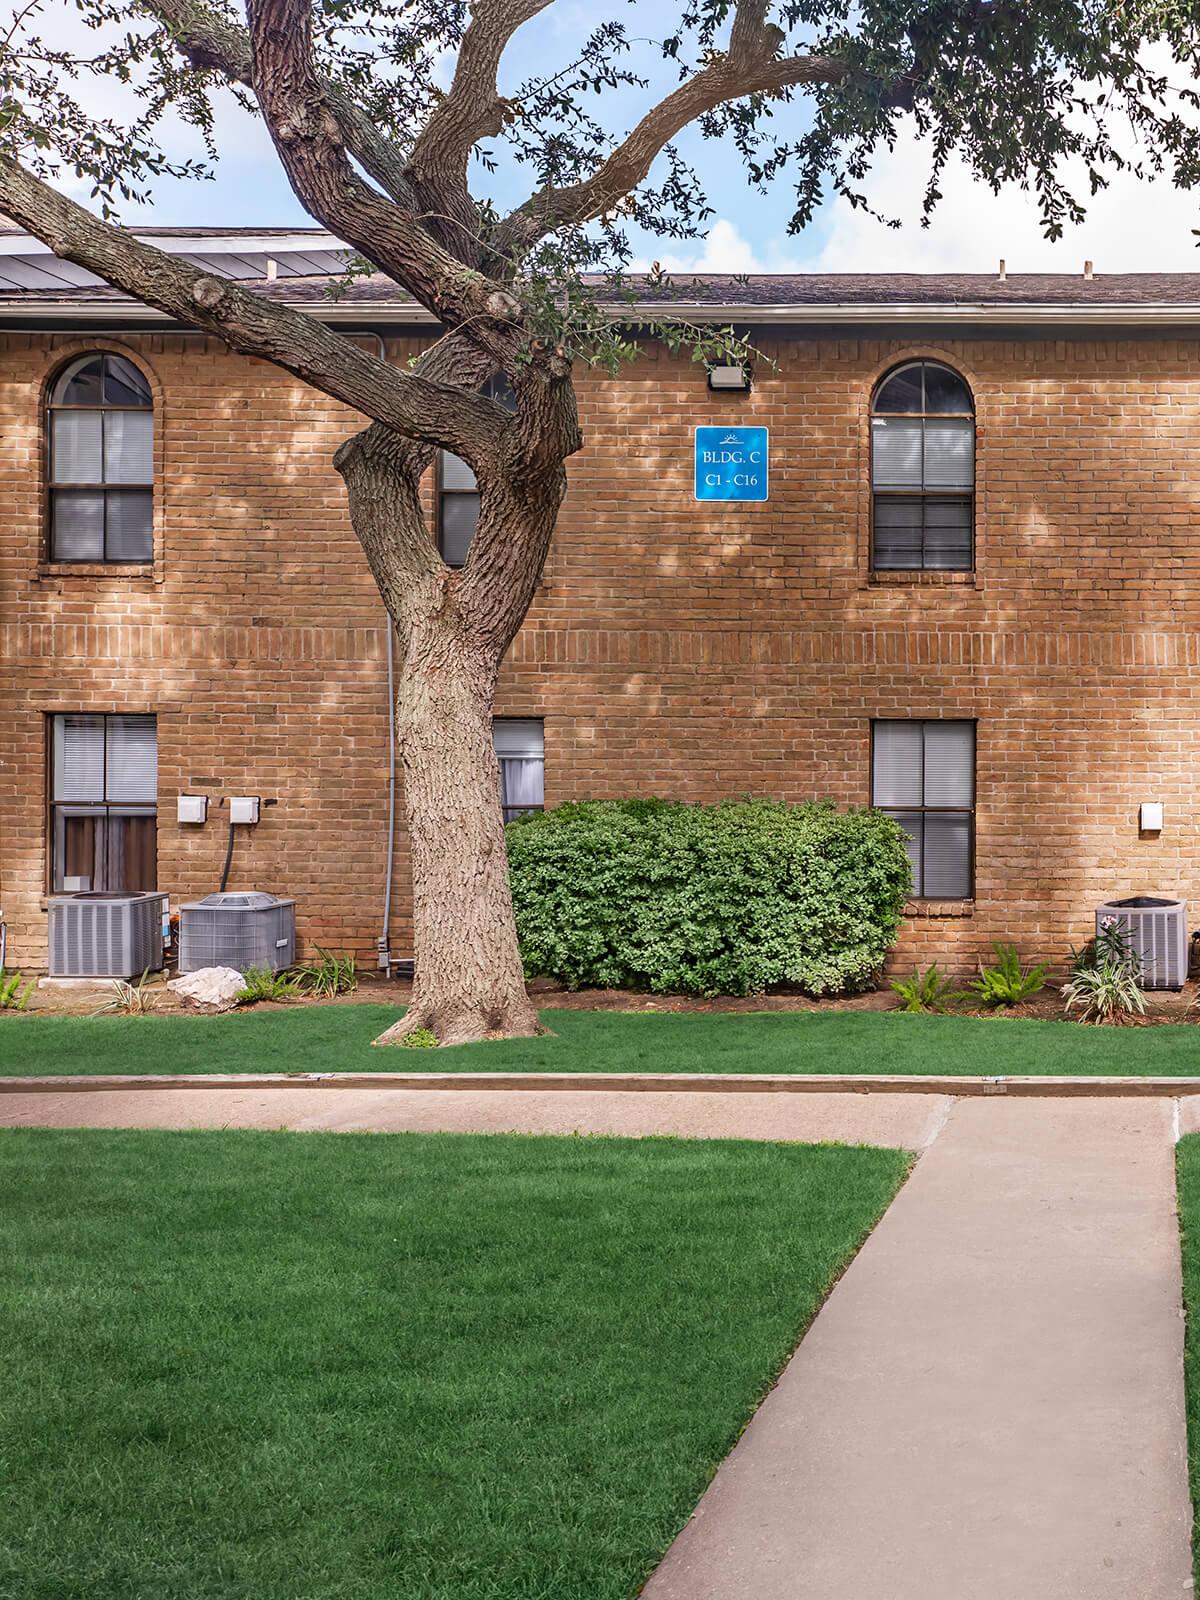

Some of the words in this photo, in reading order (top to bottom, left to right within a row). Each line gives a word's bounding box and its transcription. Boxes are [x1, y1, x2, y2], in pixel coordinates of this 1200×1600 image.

[703, 451, 746, 463] BLDG.
[749, 451, 761, 463] C
[705, 473, 722, 486] C1
[733, 473, 758, 486] C16
